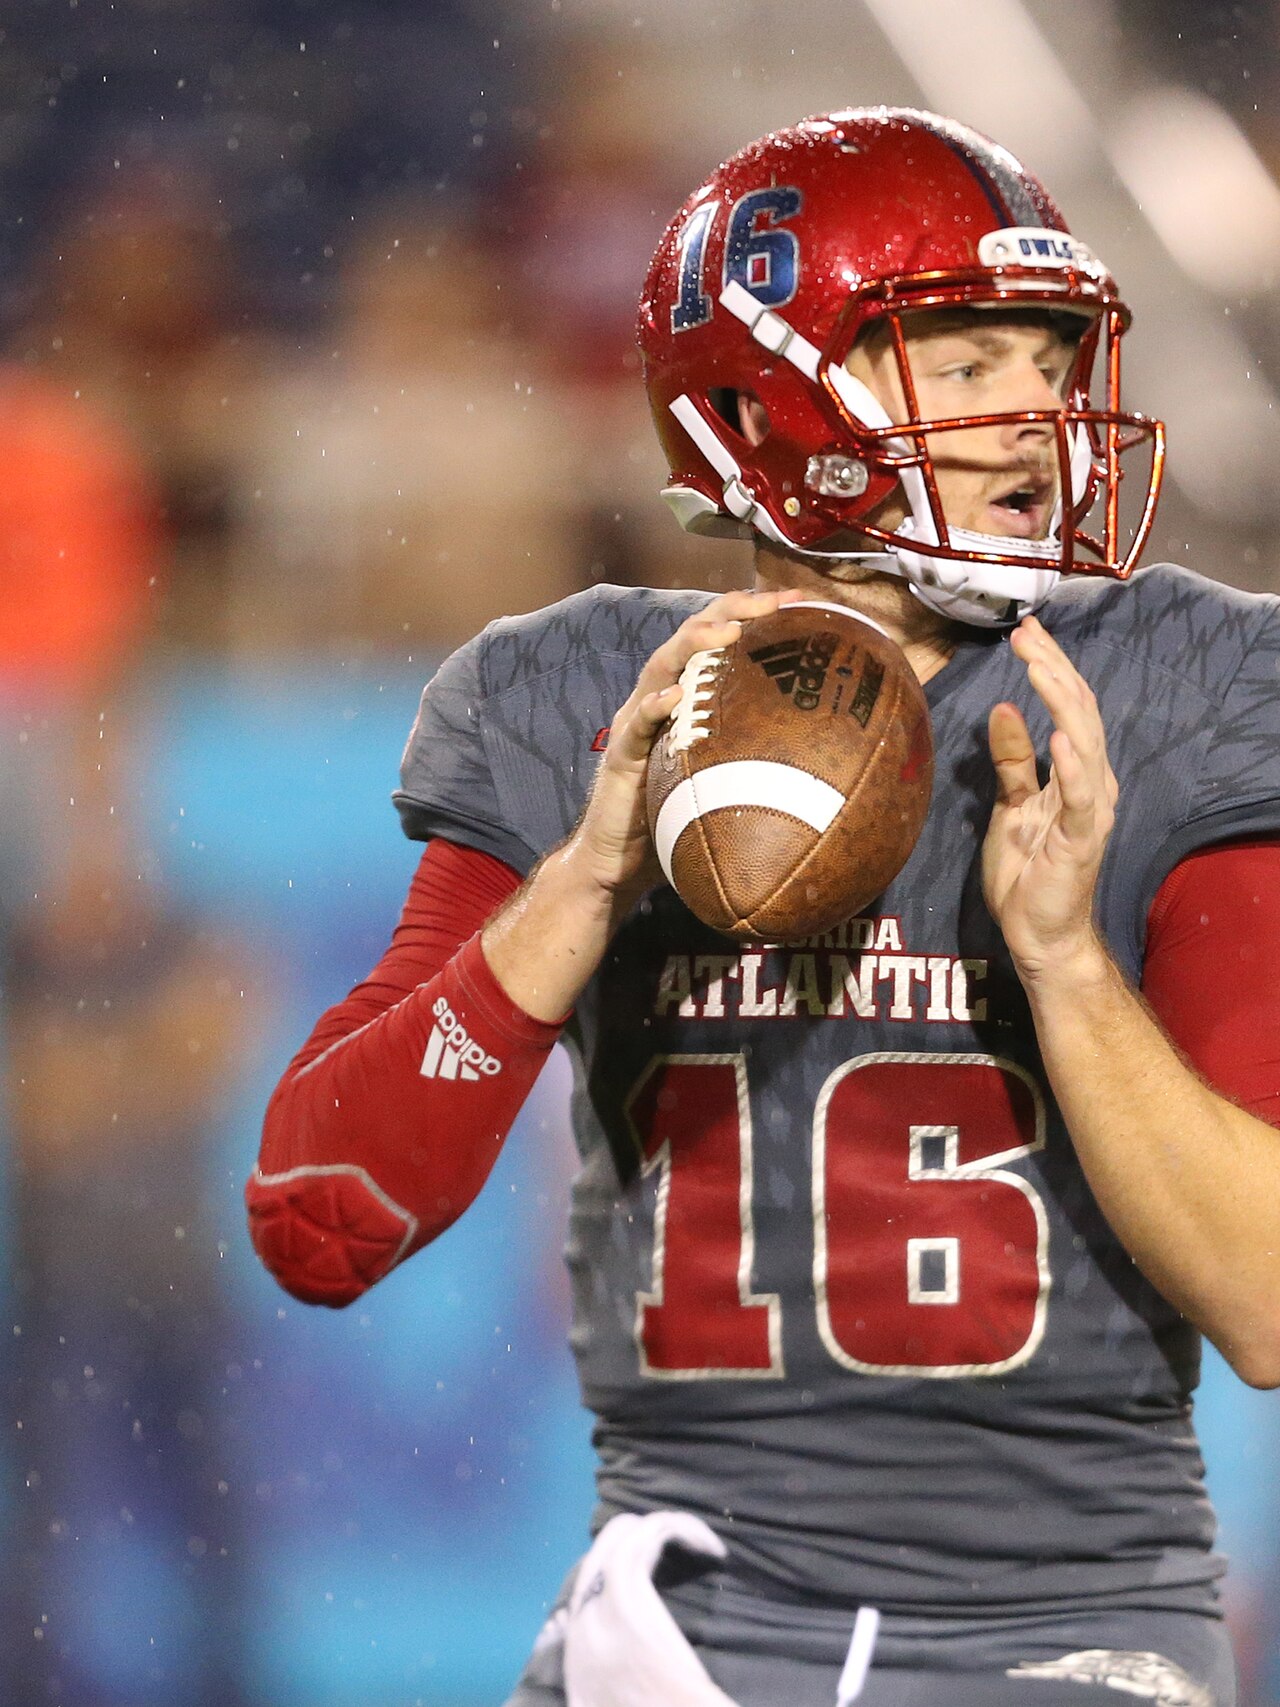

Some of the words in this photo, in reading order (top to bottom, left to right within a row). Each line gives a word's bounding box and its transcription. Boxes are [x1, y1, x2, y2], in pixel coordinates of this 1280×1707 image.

[671, 186, 803, 334] 16
[1018, 238, 1073, 259] OWLS
[654, 954, 988, 1021] ATLANTIC
[432, 996, 502, 1075] adidas
[624, 1052, 1053, 1379] 16
